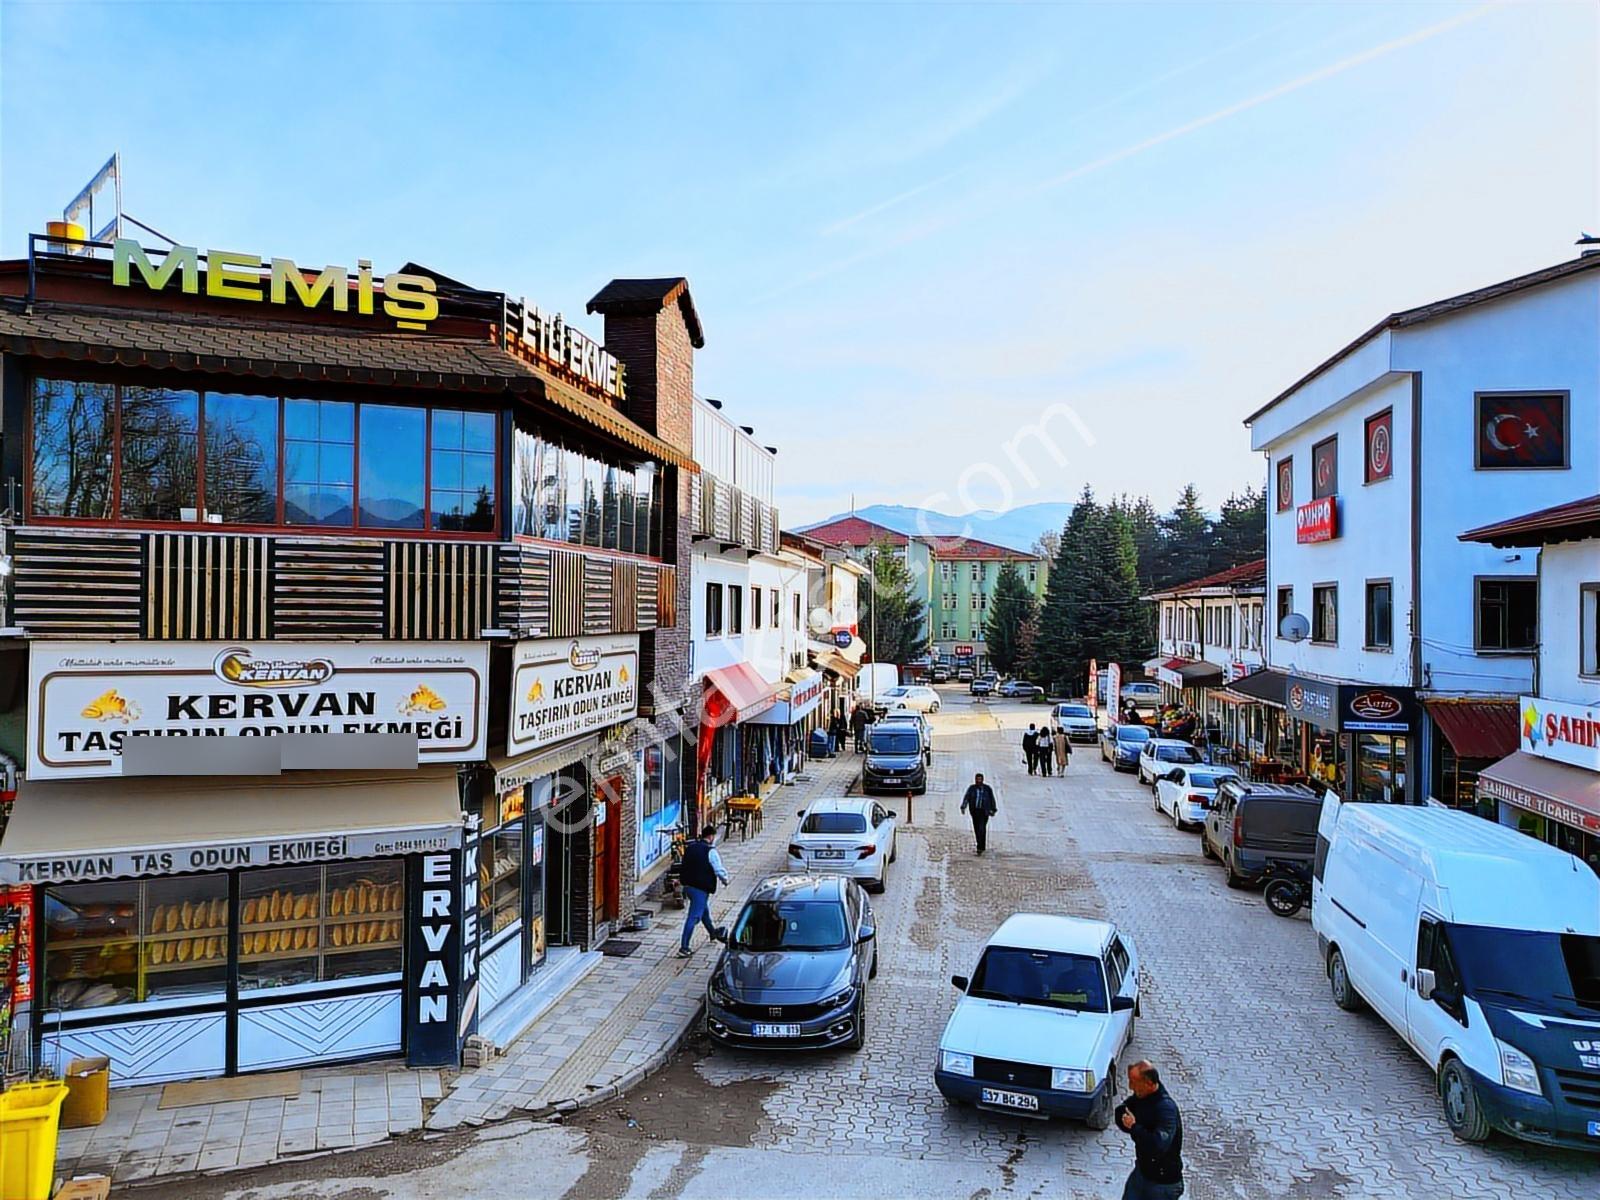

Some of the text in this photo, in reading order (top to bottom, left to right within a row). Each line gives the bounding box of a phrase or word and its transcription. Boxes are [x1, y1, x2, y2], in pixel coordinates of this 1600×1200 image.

[113, 239, 439, 331] MEMİŞ
[570, 327, 626, 401] EKMEK
[239, 669, 325, 681] KERVAN
[553, 671, 612, 699] KERVAN
[166, 692, 376, 720] KERVAN
[520, 685, 633, 731] TAŞFIRIN ODUN EKMEĞİ
[343, 716, 462, 740] EKMEĞİ
[19, 836, 347, 882] KERVAN TAŞ ODUN EKMEĞİ
[988, 1090, 1036, 1108] 37 BG 294
